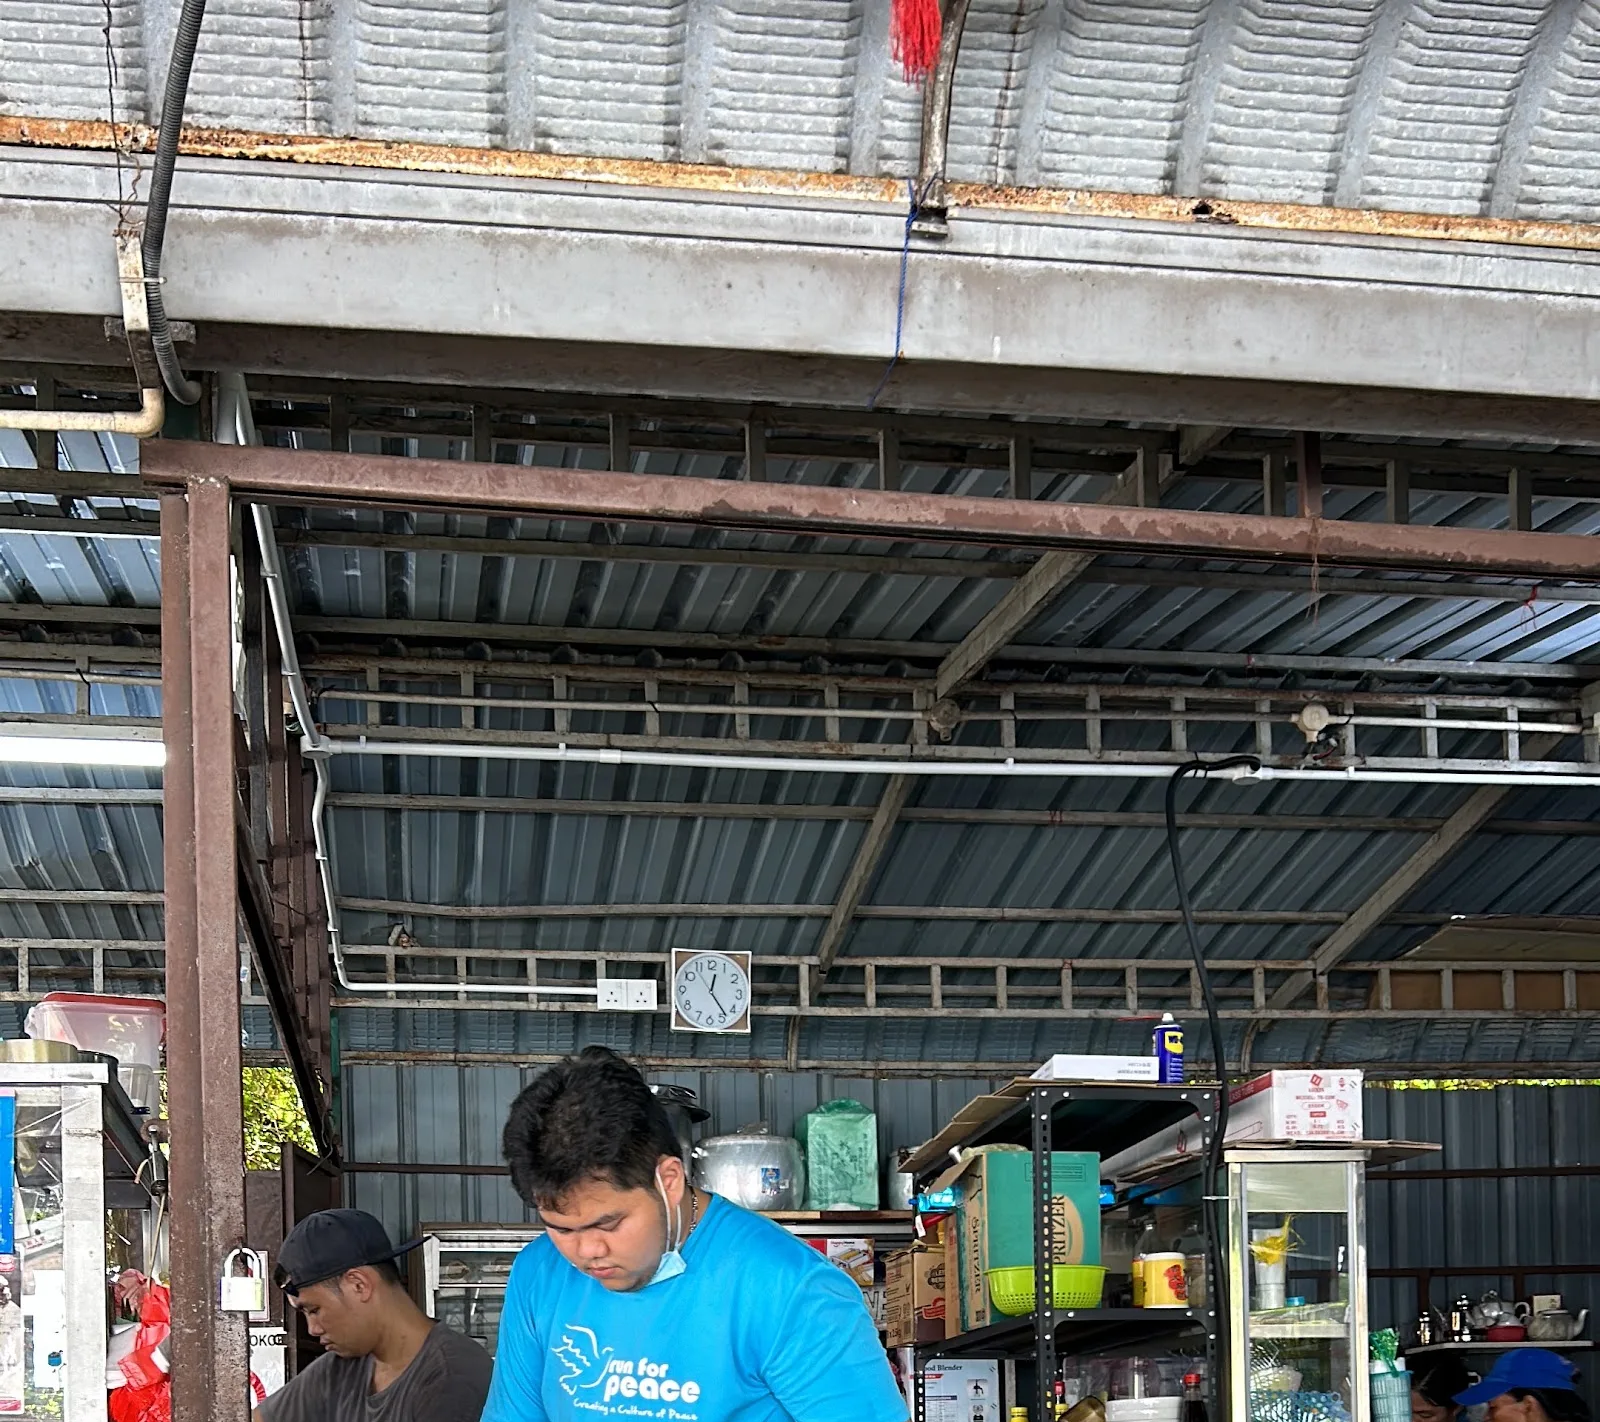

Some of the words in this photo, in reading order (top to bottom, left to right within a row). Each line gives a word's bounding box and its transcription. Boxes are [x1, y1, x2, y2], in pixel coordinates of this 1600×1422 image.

[695, 961, 703, 972] 11
[707, 959, 717, 971] 12
[685, 971, 696, 982] 10
[731, 974, 739, 984] 2
[679, 985, 687, 996] 9
[735, 989, 743, 1000] 3
[684, 1000, 692, 1011] 8
[730, 1004, 737, 1014] 4
[696, 1010, 703, 1021] 7
[706, 1015, 714, 1025] 6
[718, 1013, 726, 1023] 5
[1051, 1194, 1067, 1265] PRITZER
[971, 1216, 982, 1293] SPRITZER
[608, 1359, 634, 1375] run
[637, 1357, 669, 1378] for
[603, 1374, 700, 1404] peace
[573, 1397, 609, 1416] Creating
[617, 1404, 654, 1417] Culture
[655, 1408, 667, 1418] of
[668, 1408, 698, 1420] Peace
